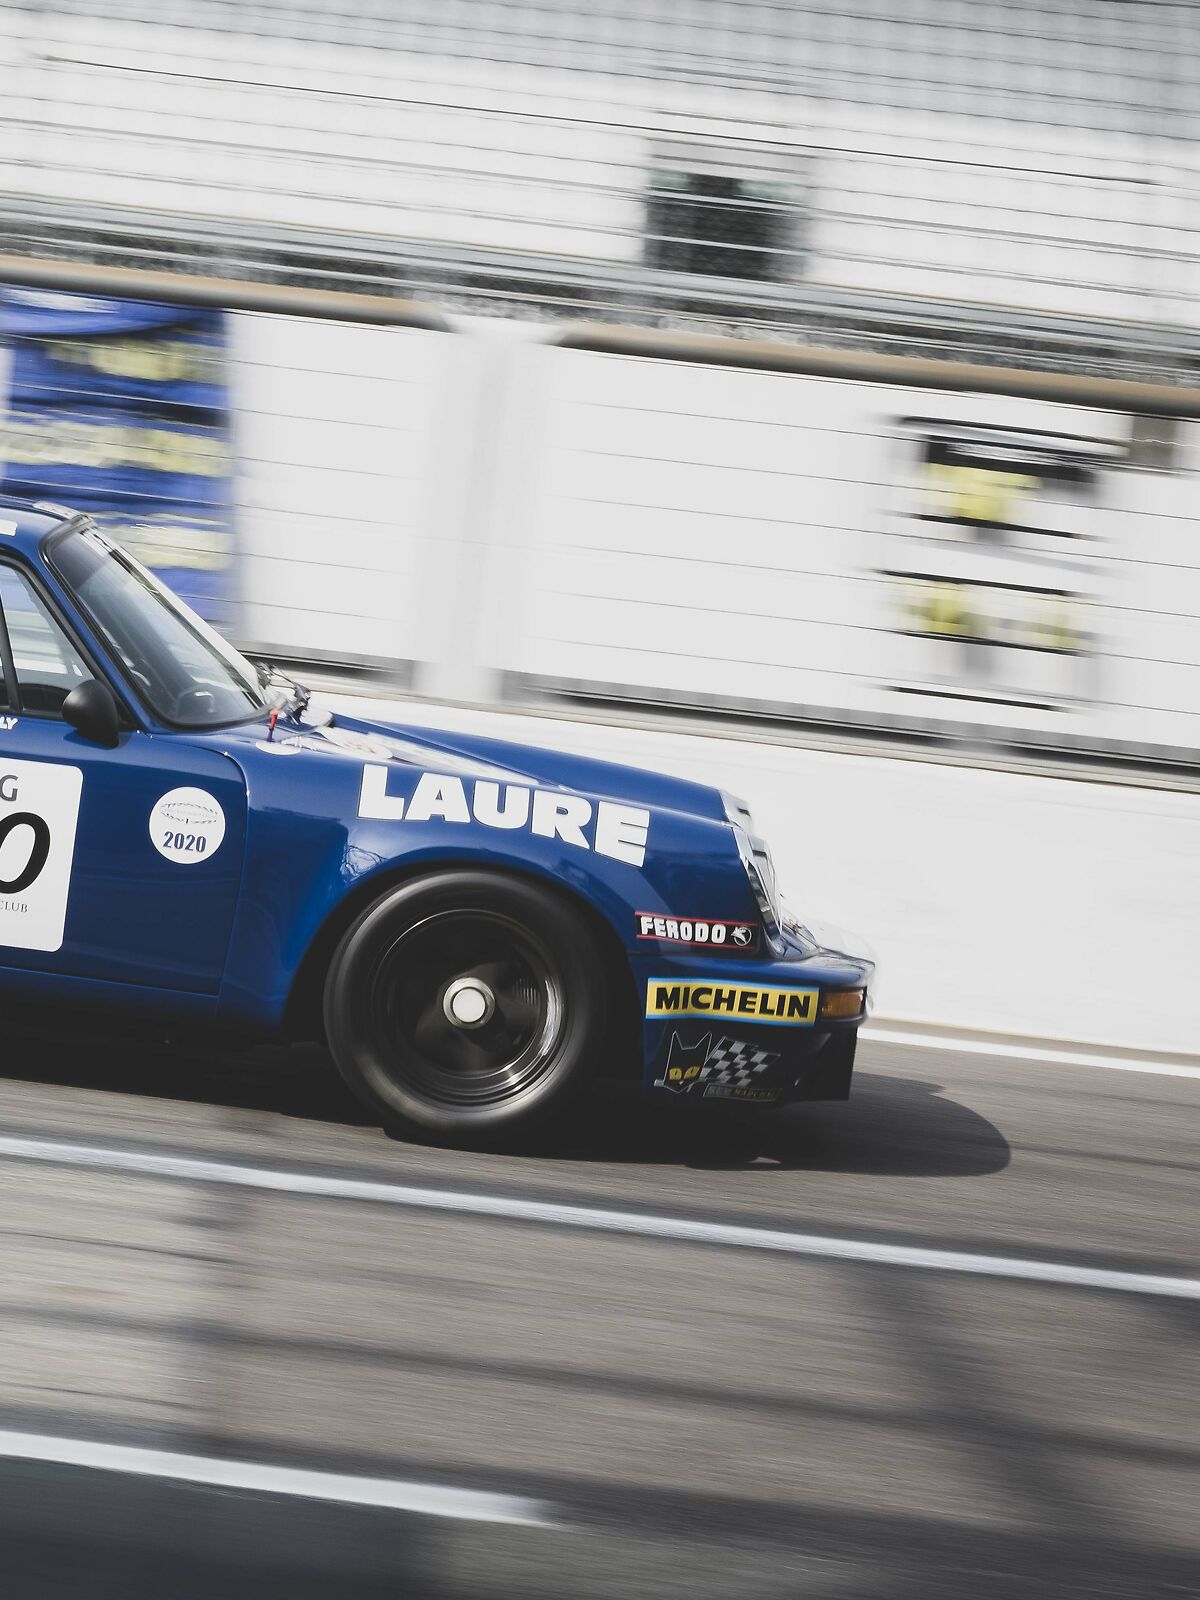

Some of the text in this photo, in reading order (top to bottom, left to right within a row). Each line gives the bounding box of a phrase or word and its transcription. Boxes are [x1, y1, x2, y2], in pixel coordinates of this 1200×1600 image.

[358, 763, 650, 868] LAURE
[163, 831, 207, 853] 2020
[640, 916, 726, 944] FERODO
[655, 987, 810, 1019] MICHELIN
